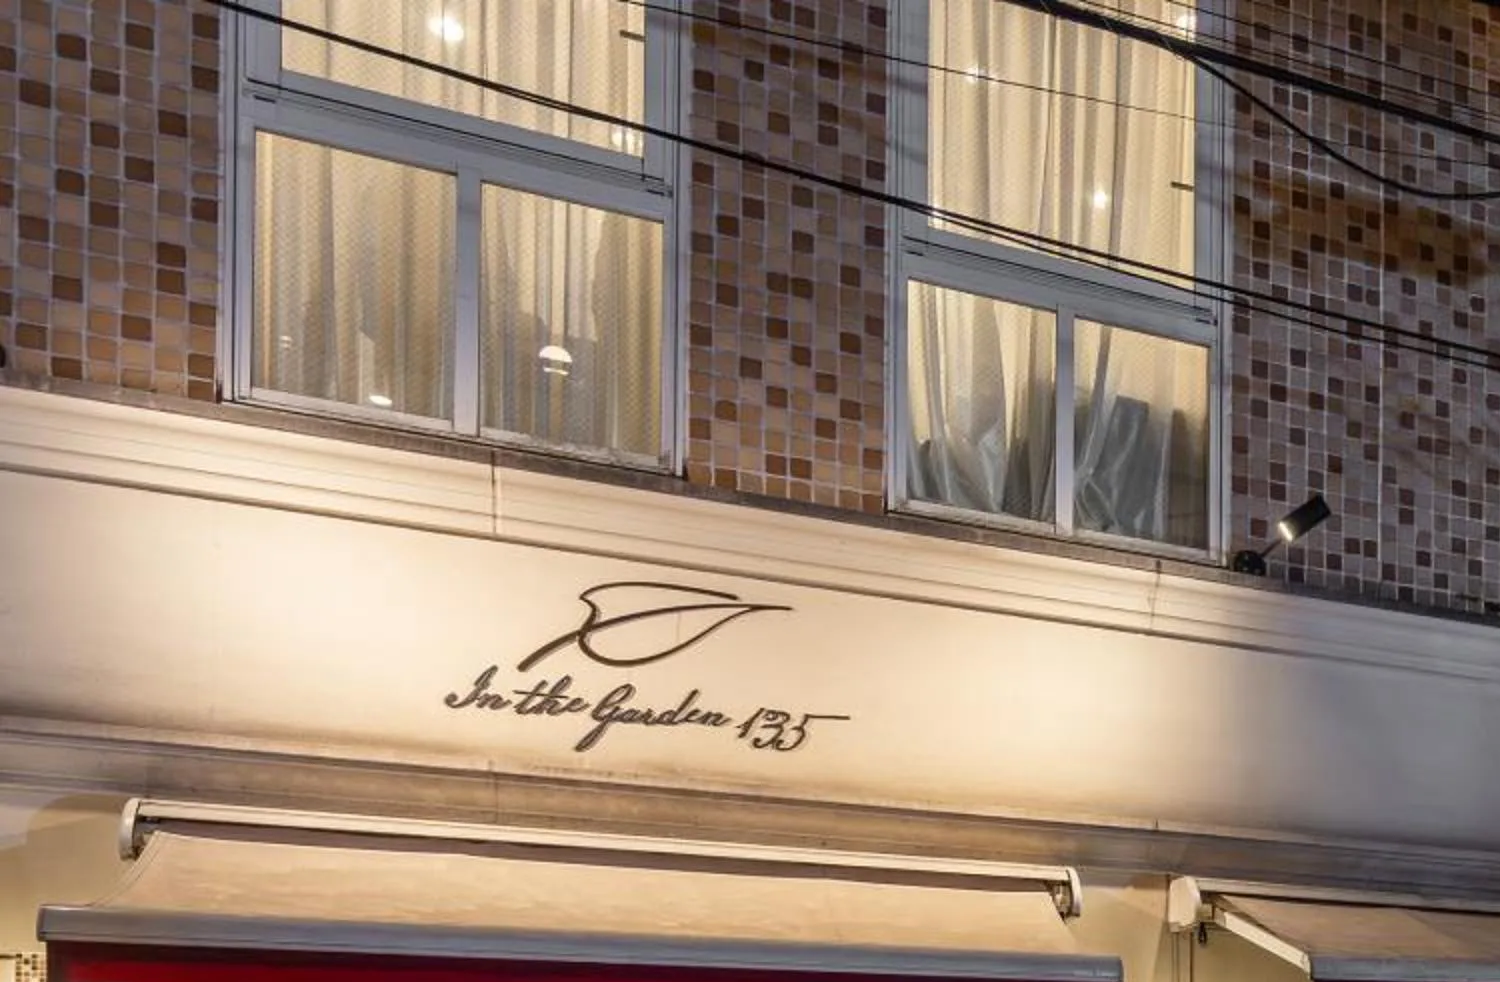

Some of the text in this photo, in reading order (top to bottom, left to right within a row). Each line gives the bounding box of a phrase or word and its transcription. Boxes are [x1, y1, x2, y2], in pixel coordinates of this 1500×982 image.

[445, 665, 851, 753] In the Garden 135
